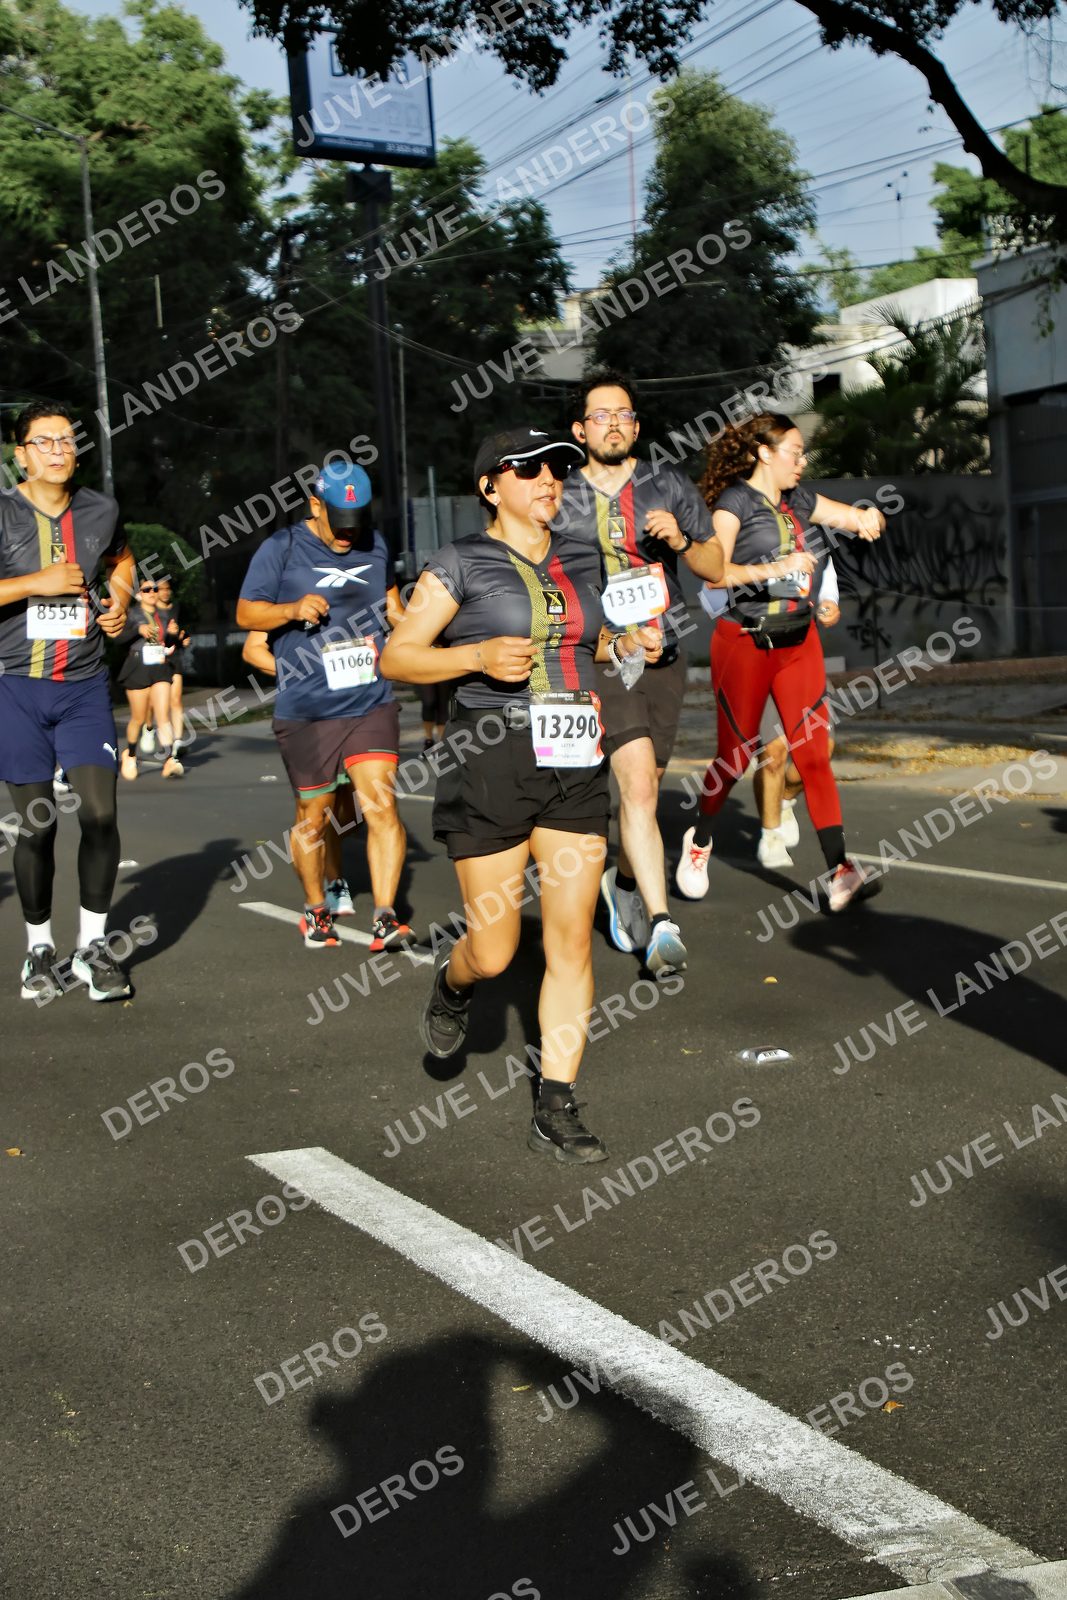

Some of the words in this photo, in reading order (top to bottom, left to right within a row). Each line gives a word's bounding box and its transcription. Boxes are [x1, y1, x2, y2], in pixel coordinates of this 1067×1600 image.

[606, 582, 657, 608] 13315
[37, 604, 77, 620] 8554
[329, 652, 373, 672] 11066
[537, 714, 598, 739] 13290
